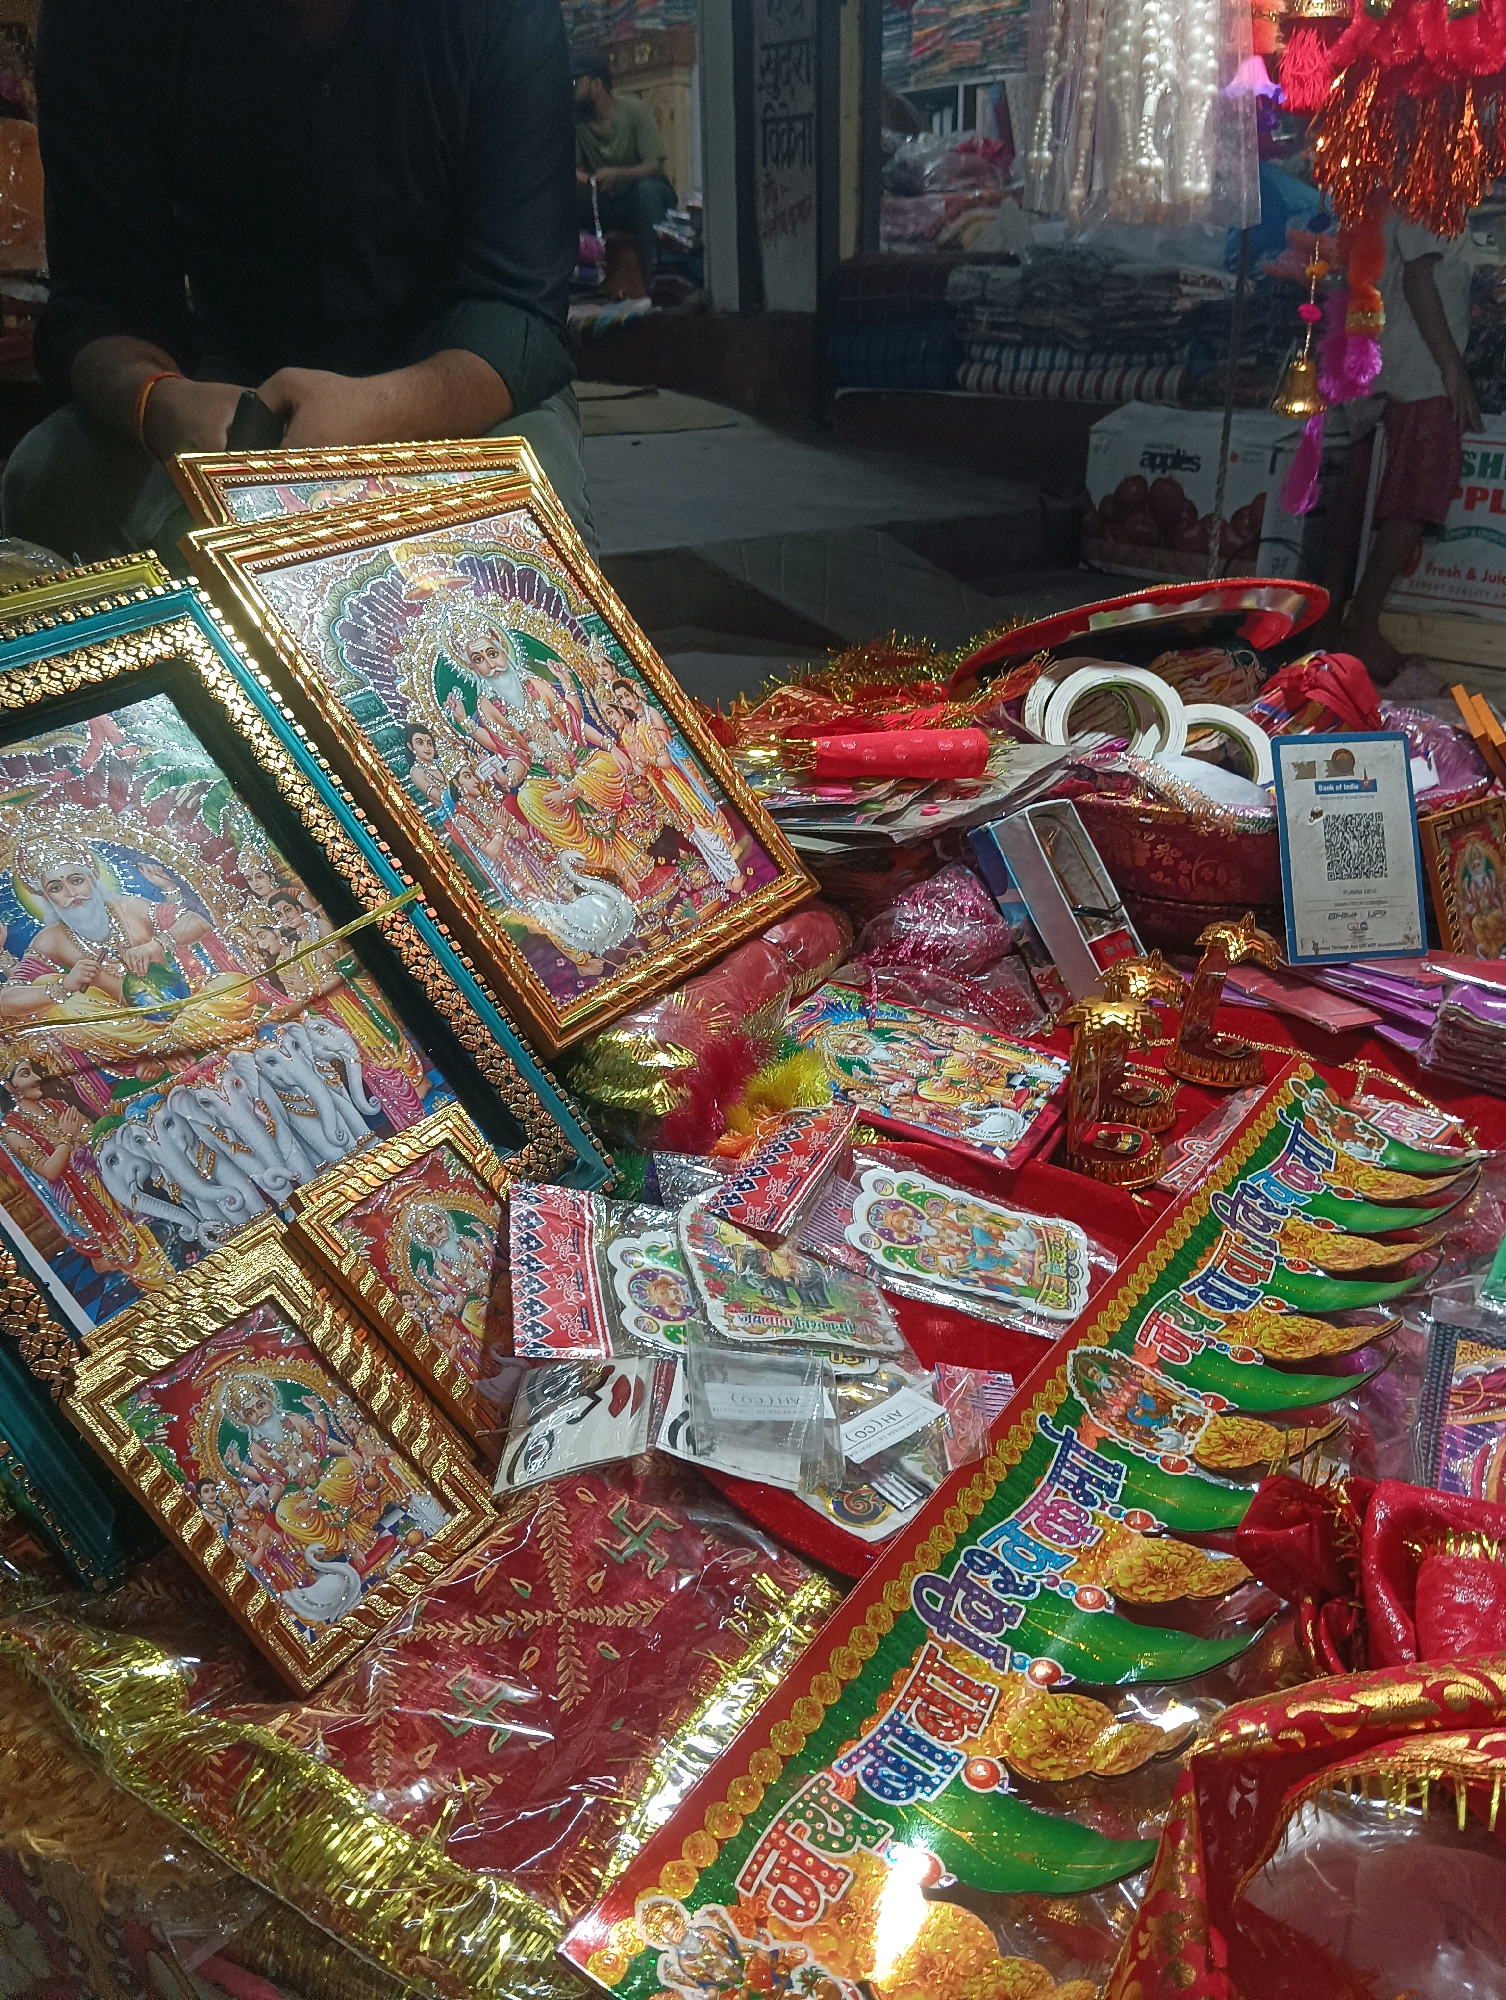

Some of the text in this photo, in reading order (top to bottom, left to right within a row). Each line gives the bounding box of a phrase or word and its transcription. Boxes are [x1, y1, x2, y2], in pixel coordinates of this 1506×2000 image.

[1461, 450, 1506, 480] SH
[1318, 784, 1335, 792] Bank
[1210, 1106, 1339, 1257] विश्वकर्मा
[1180, 1231, 1277, 1315] बाबा
[1133, 1291, 1227, 1367] जय
[735, 1412, 1130, 1928] जय बाबा विश्वकर्मा
